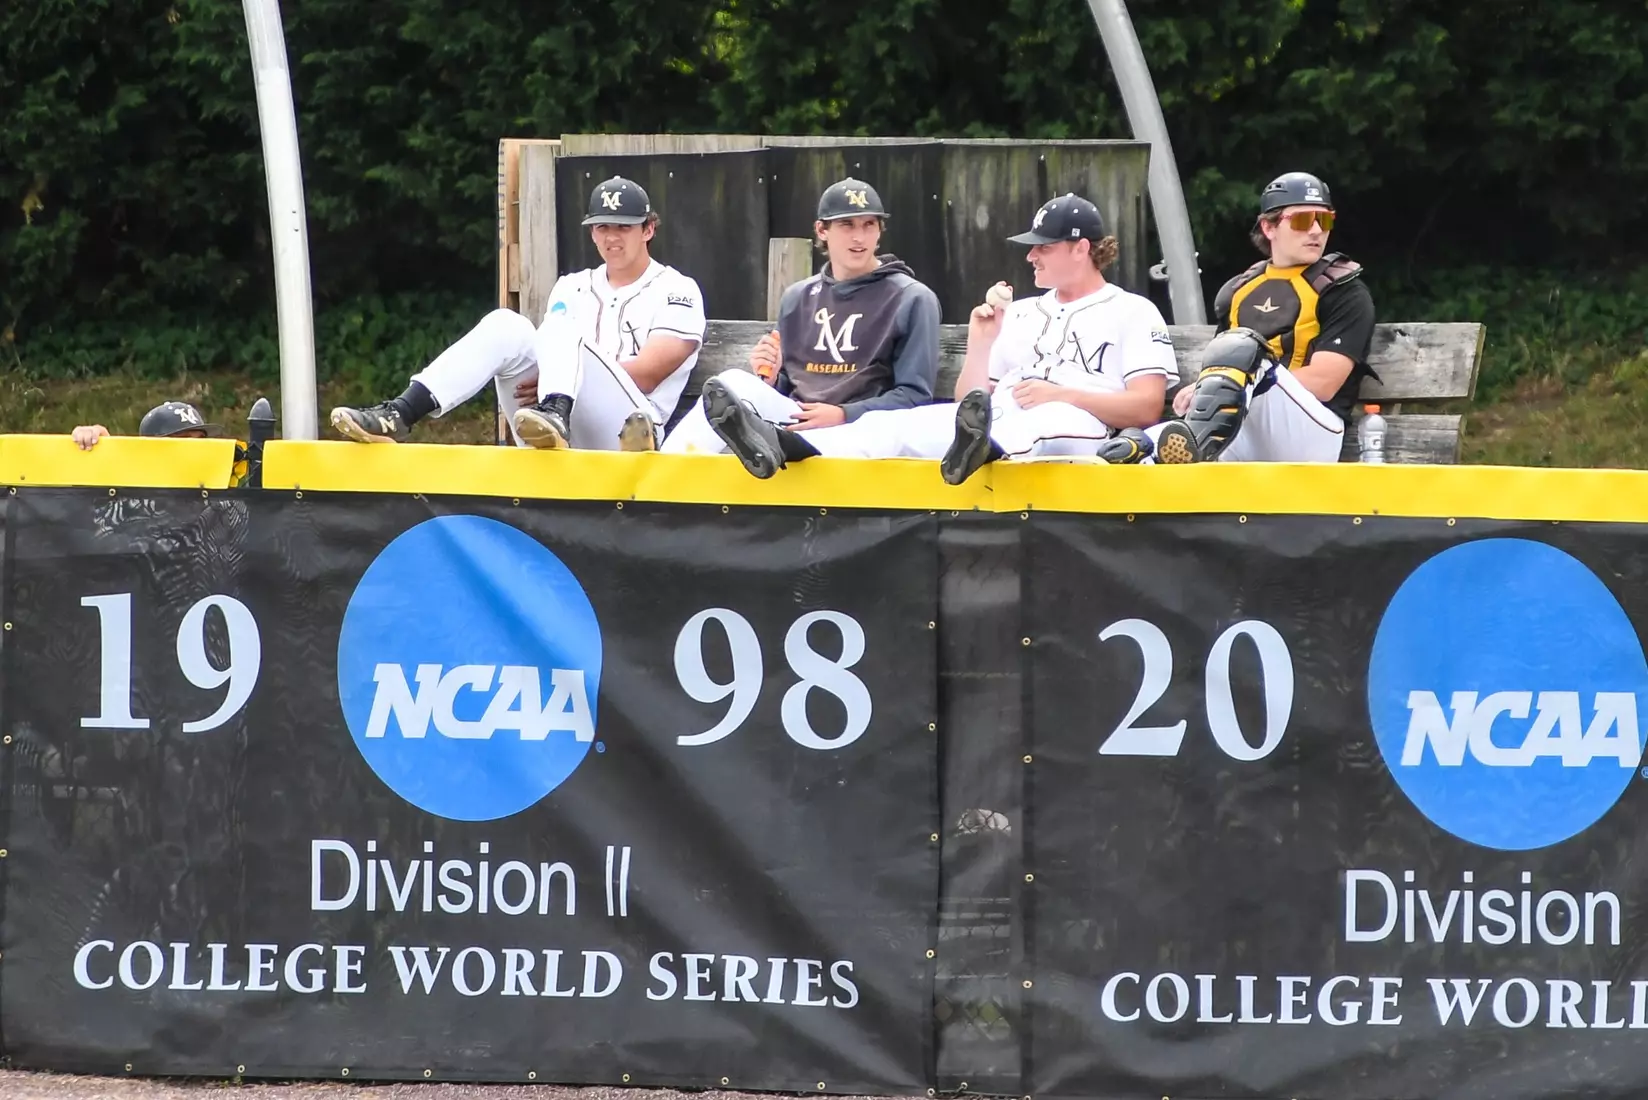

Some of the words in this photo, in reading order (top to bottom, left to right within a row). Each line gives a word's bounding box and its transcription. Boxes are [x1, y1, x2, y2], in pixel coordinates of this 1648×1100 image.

[600, 190, 623, 211] M
[845, 189, 870, 209] M
[806, 362, 857, 374] BASEBALL
[813, 307, 863, 363] M
[80, 592, 261, 733] 19
[673, 607, 873, 750] 98
[365, 663, 595, 742] NCAA
[1098, 618, 1294, 761] 20
[1401, 690, 1642, 767] NCAA
[311, 839, 576, 916] Division
[605, 845, 631, 917] II
[1345, 869, 1621, 946] Division
[73, 939, 367, 994] COLLEGE
[387, 946, 623, 998] WORLD
[646, 951, 859, 1009] SERIES
[1100, 972, 1403, 1026] COLLEGE
